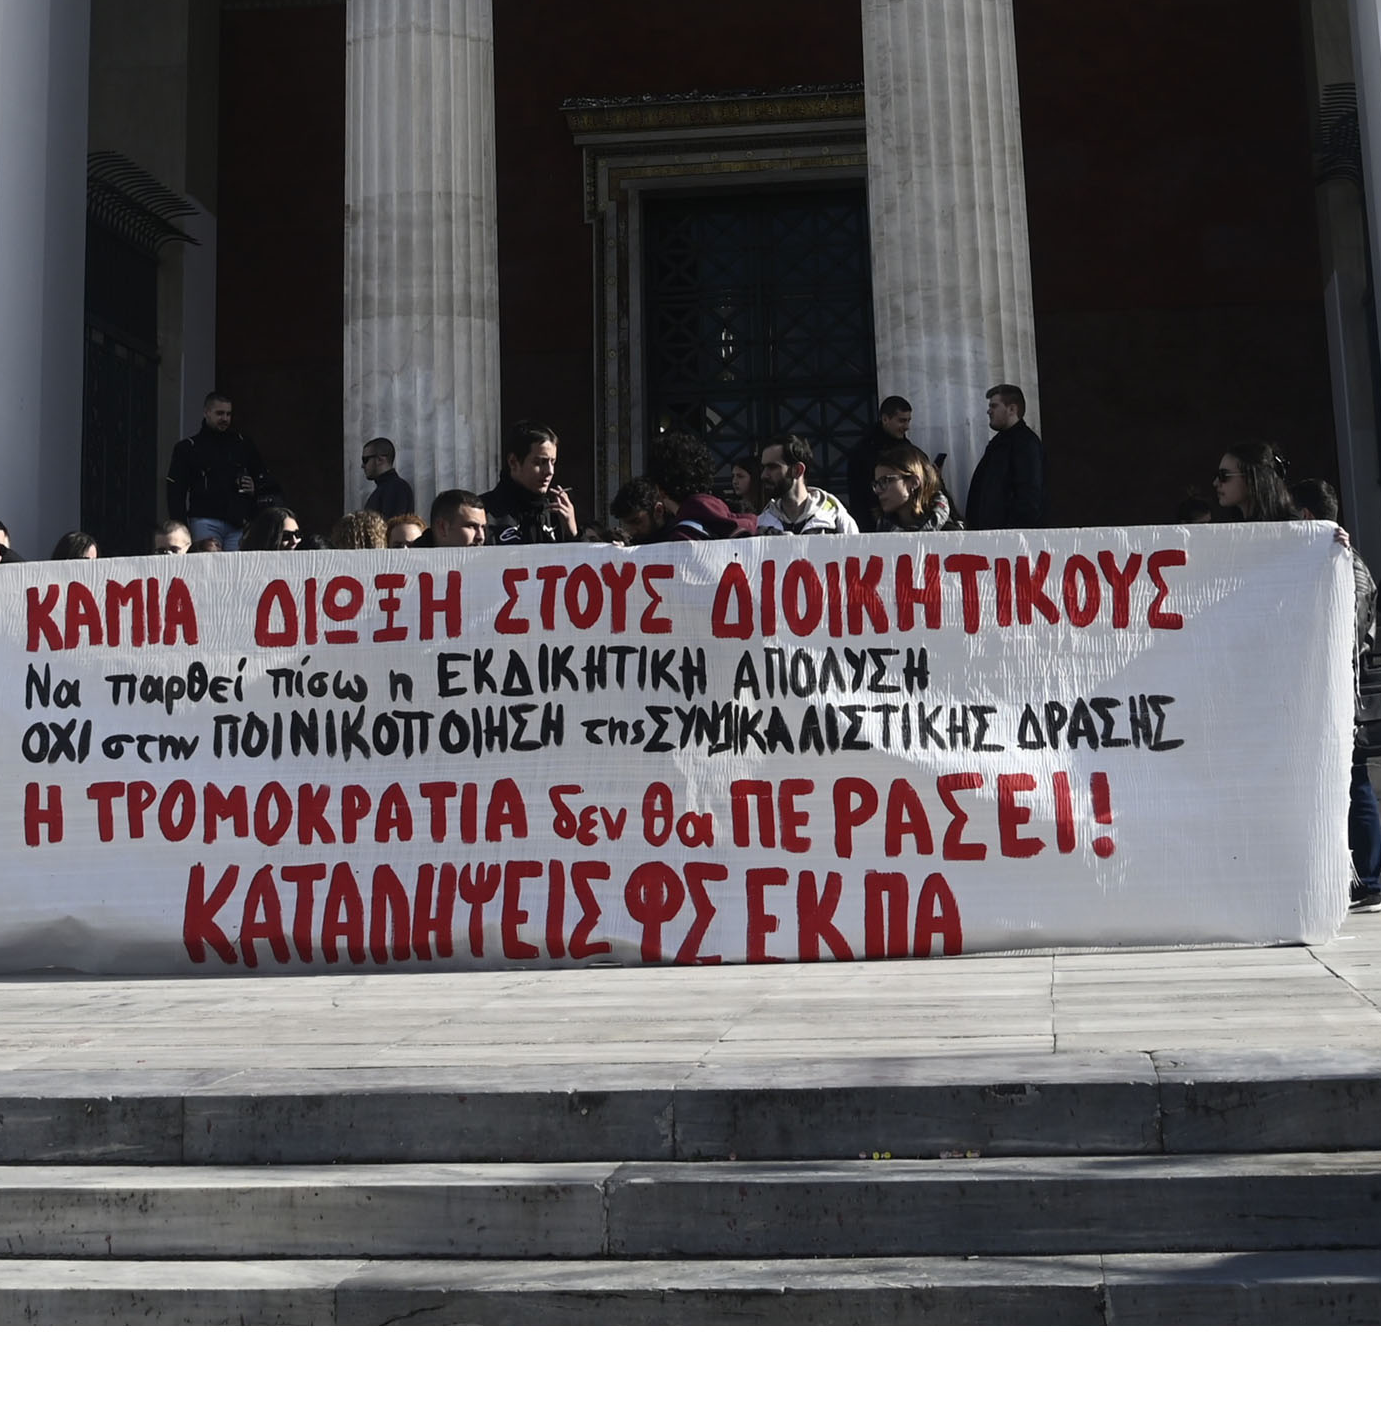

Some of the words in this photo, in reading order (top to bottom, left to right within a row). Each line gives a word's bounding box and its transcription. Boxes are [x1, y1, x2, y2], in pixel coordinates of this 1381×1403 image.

[26, 577, 198, 652] ΚΑΜΙΑ
[254, 570, 462, 648] ΔΙΩΞΗ
[494, 562, 675, 635] ΣΤΟΥΣ
[711, 549, 1187, 640] ΔΙΟΙΚΗΤΙΚΟΥΣ
[25, 662, 81, 710] Να
[105, 657, 247, 716] παρθεί
[266, 656, 368, 703] πίσω
[389, 669, 414, 703] η
[437, 643, 708, 702] ΕΚΔΙΚΗΤΙΚΗ
[733, 646, 930, 701] ΑΠΟΛΥΣΗ
[21, 718, 92, 764] ΟΧΙ
[101, 733, 200, 764] στην
[213, 701, 564, 763] ΠΟΙΝΙΚΟΠΟΙΗΣΗ
[1017, 693, 1186, 752] ΔΡΑΣΗΣ
[24, 782, 63, 847] Η
[87, 777, 528, 847] ΤΡΟΜΟΚΡΑΤΙΑ
[549, 784, 627, 847] δεν
[642, 781, 714, 848] θα
[730, 771, 1115, 861] ΠΕΡΑΣΕΙ!
